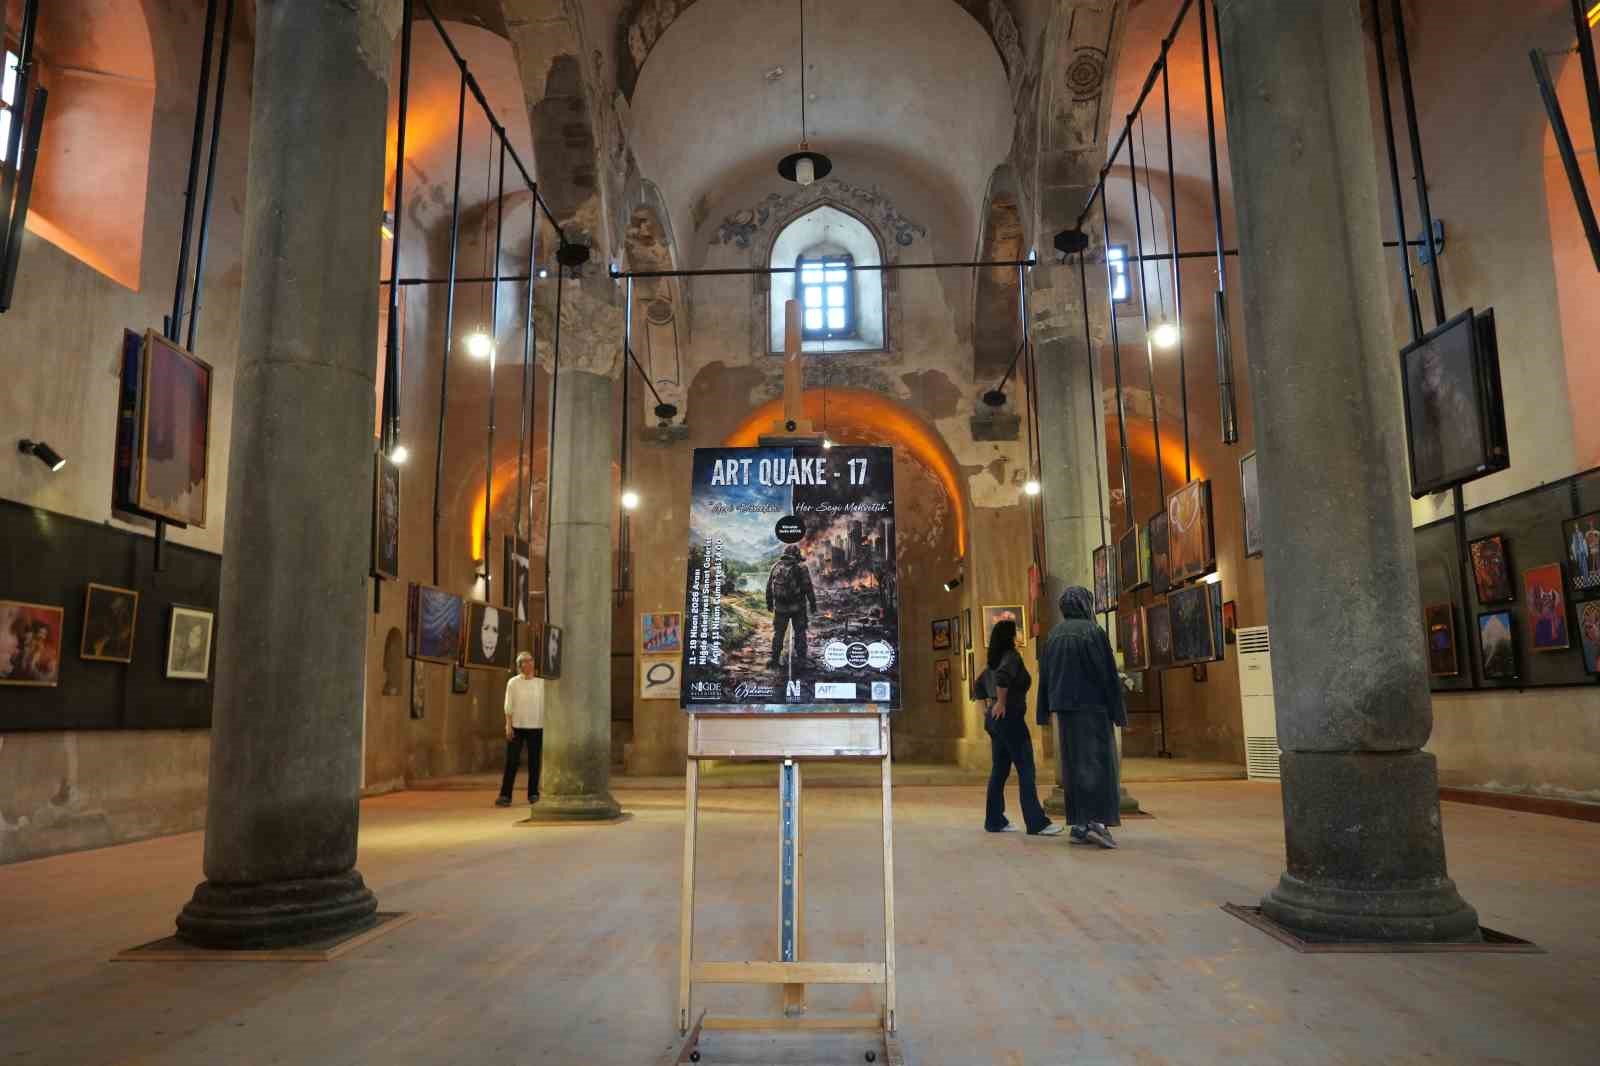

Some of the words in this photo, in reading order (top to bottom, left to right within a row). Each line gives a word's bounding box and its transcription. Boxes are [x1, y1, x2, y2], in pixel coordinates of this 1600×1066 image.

[711, 459, 752, 485] ART
[758, 459, 827, 487] QUAKE
[847, 459, 868, 485] 17
[691, 614, 699, 638] Nisan
[712, 605, 720, 631] Nisan
